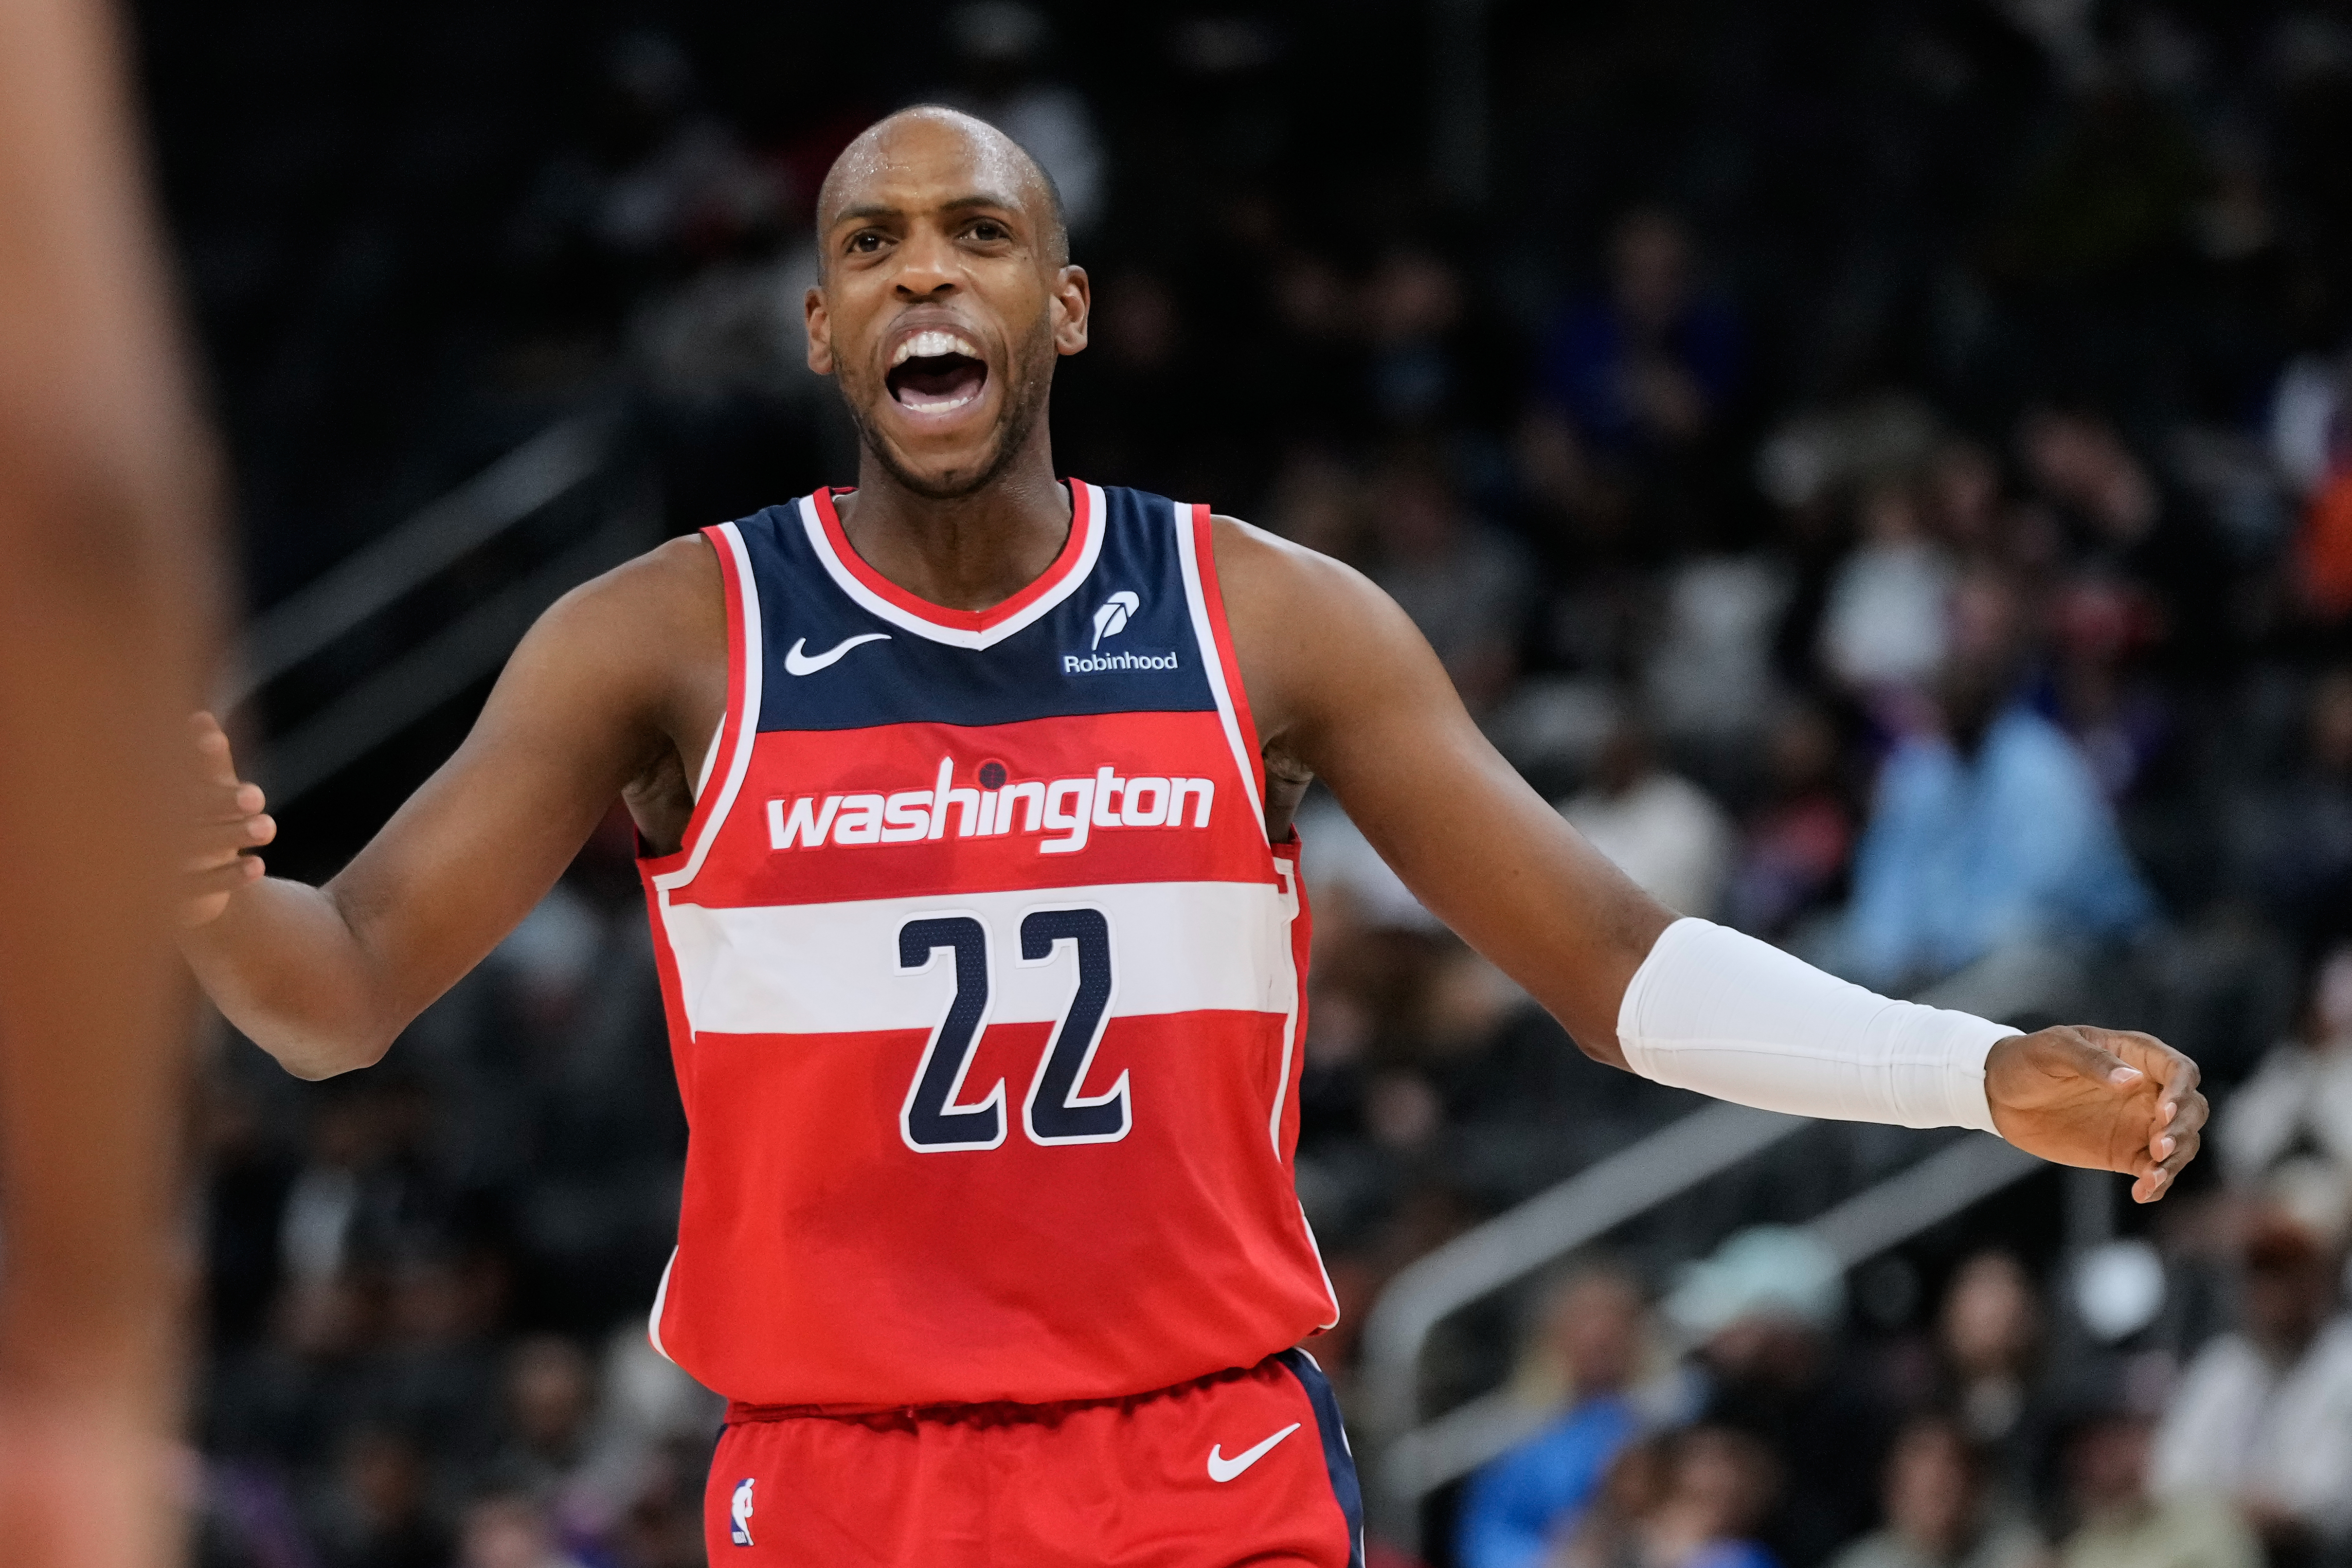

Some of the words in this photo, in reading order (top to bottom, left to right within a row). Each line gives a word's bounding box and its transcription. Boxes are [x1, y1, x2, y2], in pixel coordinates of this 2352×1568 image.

[1063, 651, 1178, 673] Robinhood
[767, 756, 1215, 854] washington
[894, 903, 1132, 1153] 22
